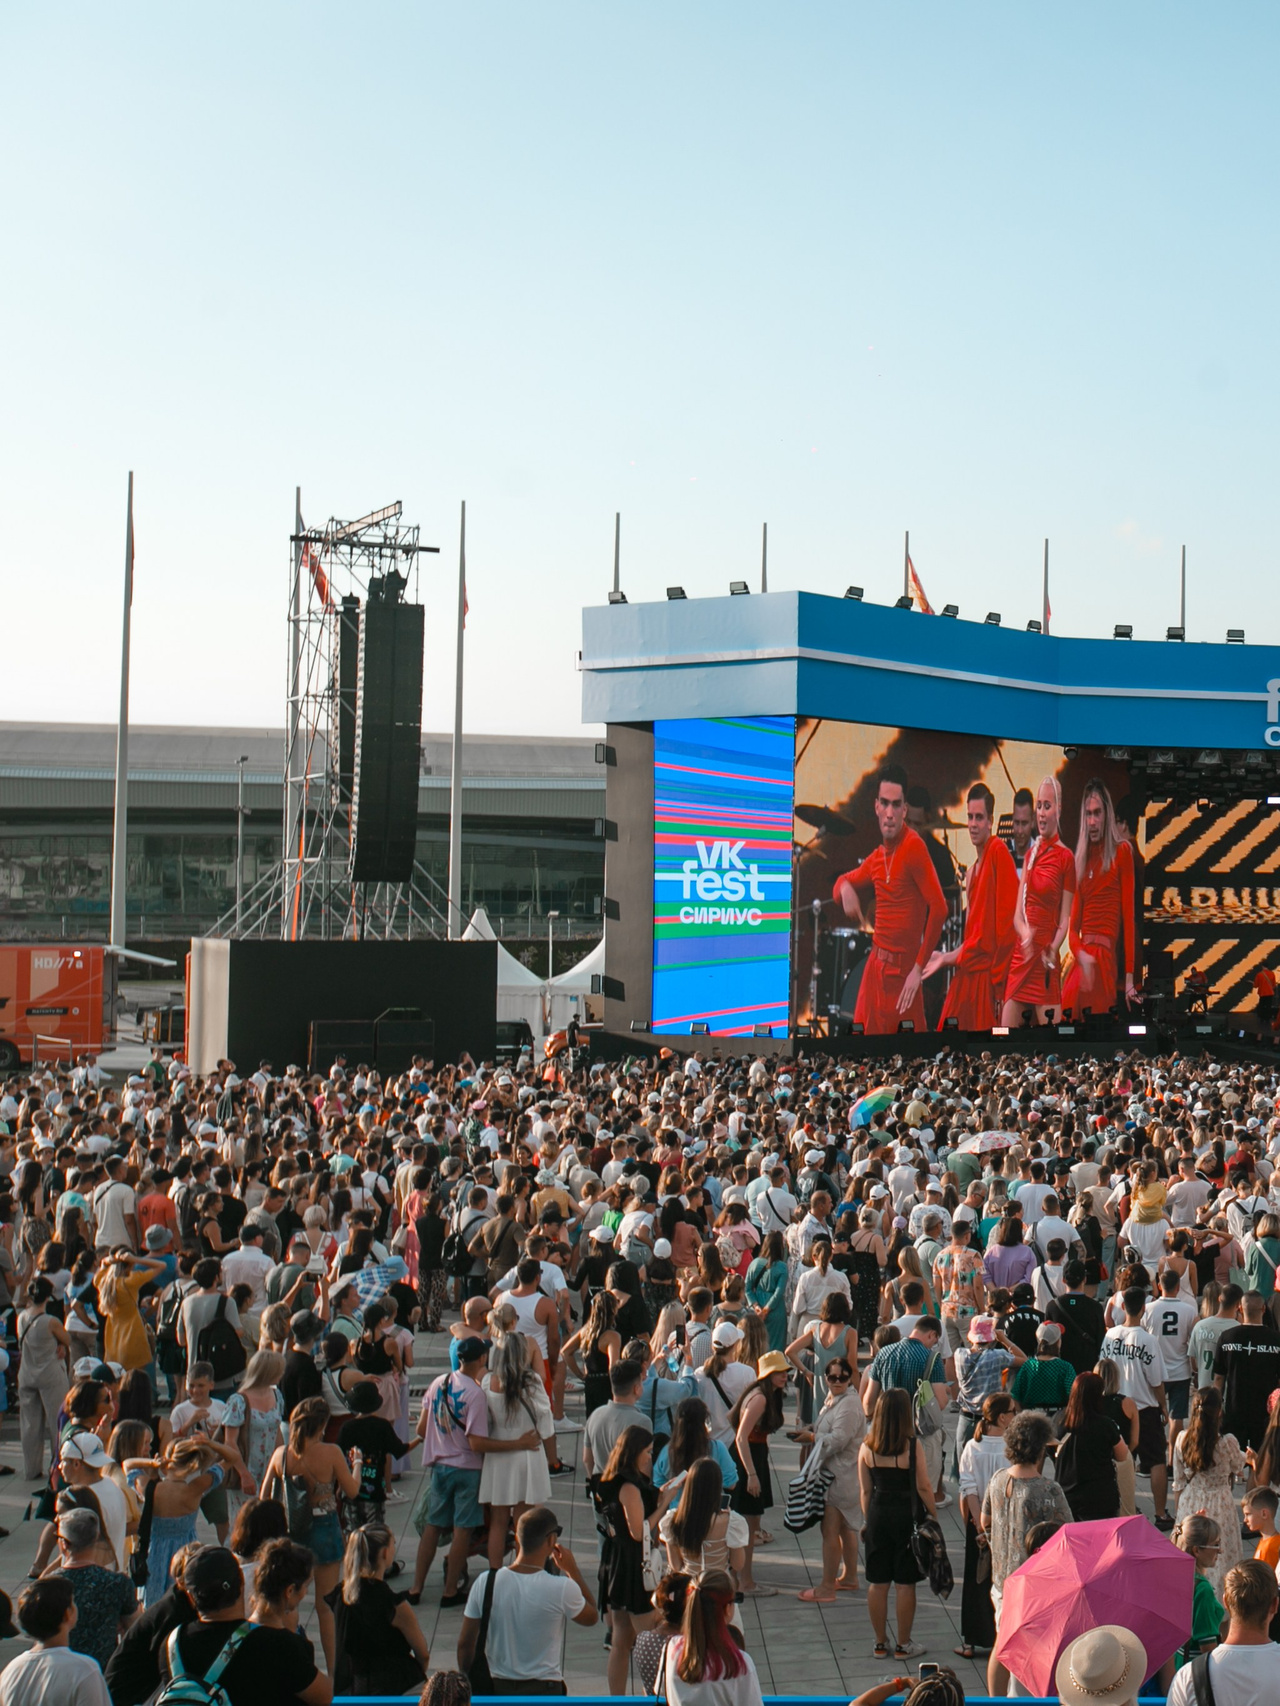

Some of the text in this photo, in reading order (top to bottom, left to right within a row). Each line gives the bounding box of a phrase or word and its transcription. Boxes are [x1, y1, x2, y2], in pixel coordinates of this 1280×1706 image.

[695, 841, 747, 869] VK
[682, 860, 765, 901] fest
[680, 906, 762, 926] СИРИУС
[1162, 1311, 1178, 1336] 2
[1112, 1338, 1156, 1366] Angeles
